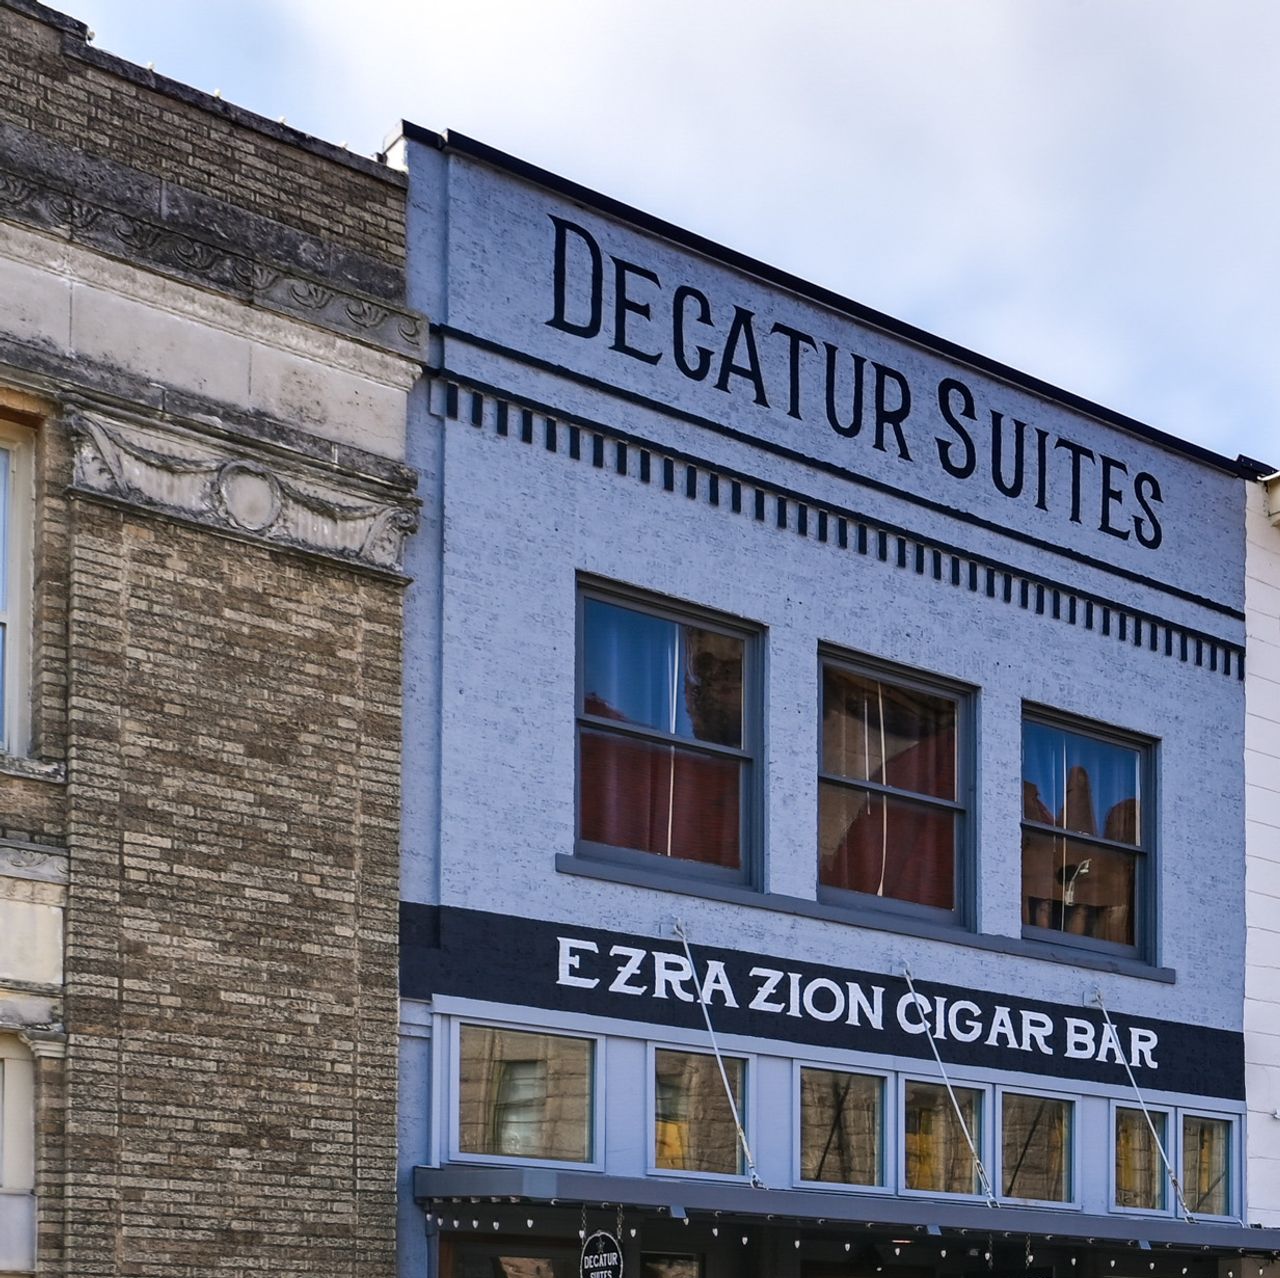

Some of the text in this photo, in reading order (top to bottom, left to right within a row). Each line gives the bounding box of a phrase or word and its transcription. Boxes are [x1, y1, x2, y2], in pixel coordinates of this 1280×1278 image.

[545, 213, 1164, 550] DECATUR SUITES
[555, 937, 1159, 1069] EZRA ZION CIGAR BAR
[584, 1252, 618, 1269] DECATUR
